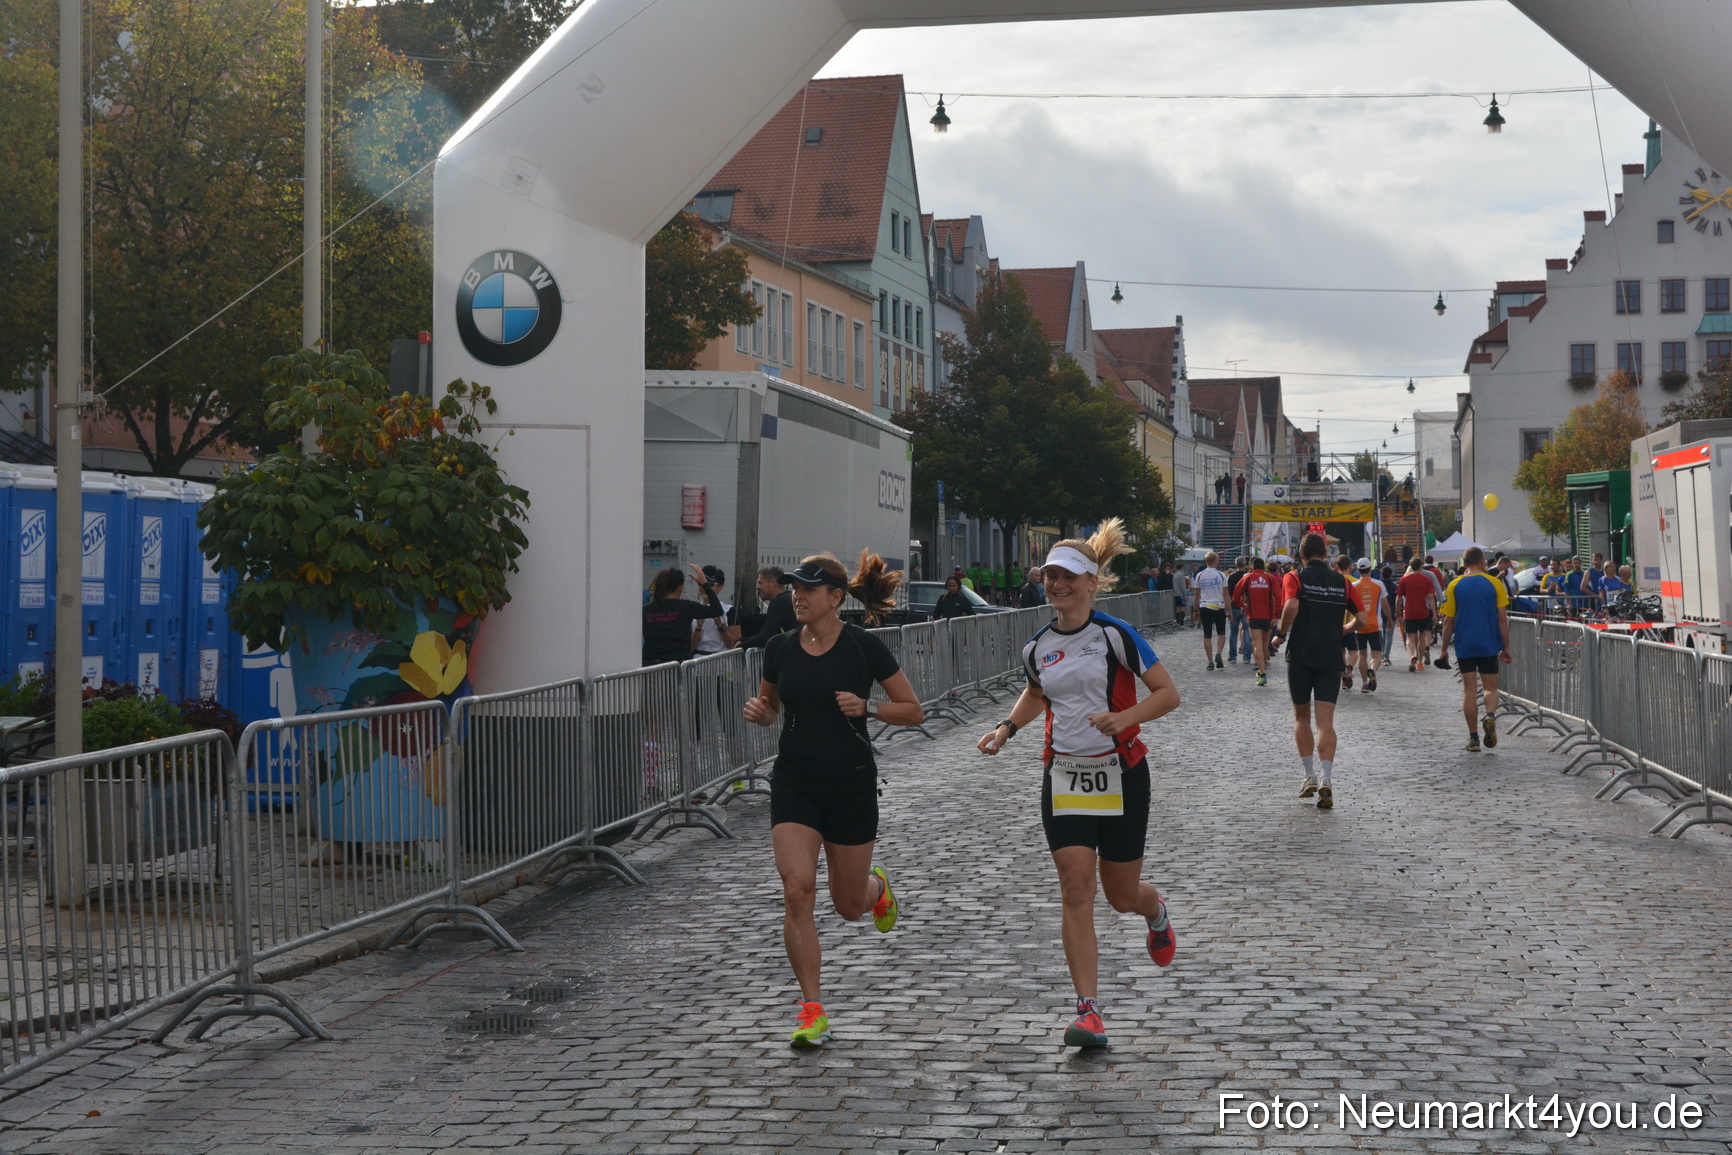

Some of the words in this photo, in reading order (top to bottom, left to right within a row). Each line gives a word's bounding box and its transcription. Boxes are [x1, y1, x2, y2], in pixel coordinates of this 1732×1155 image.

[463, 252, 554, 291] BMW
[878, 469, 906, 513] BOCK
[1291, 507, 1334, 518] START
[1055, 760, 1075, 769] PARTL
[1066, 771, 1108, 793] 750
